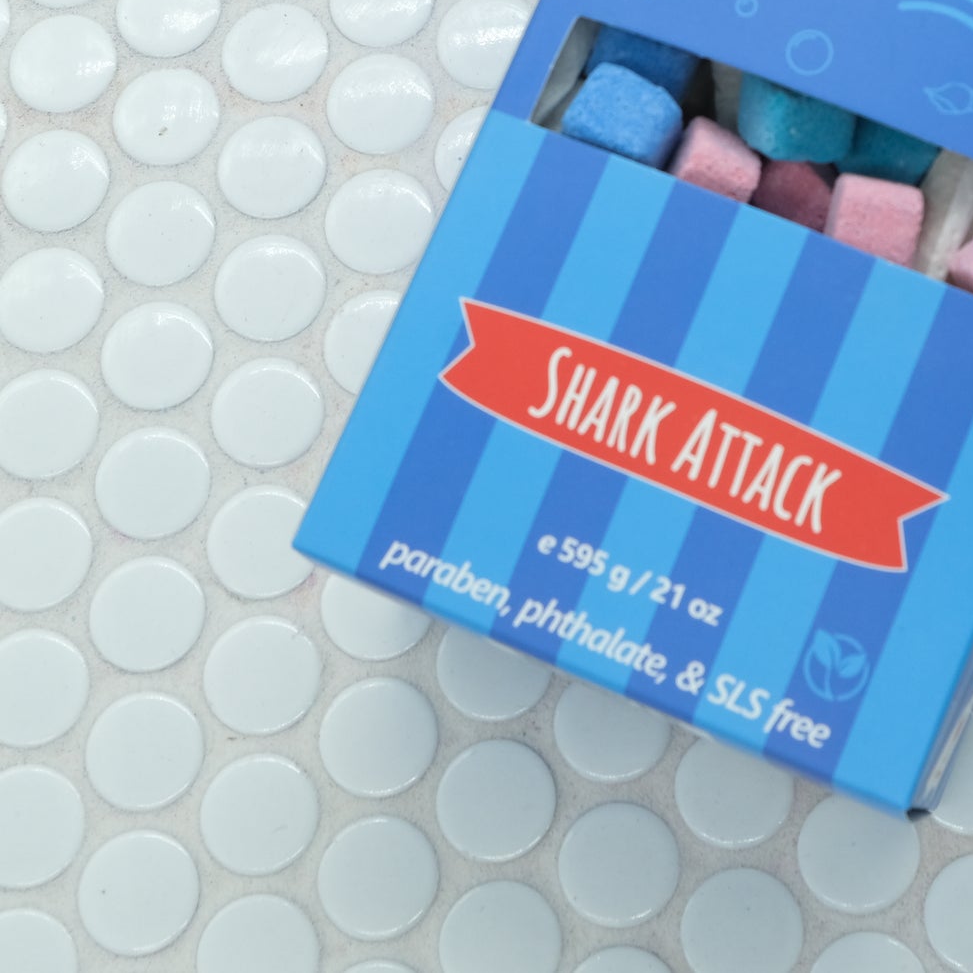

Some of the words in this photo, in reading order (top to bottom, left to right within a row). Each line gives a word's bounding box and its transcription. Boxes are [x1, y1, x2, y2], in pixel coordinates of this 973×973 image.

[527, 346, 677, 465] SHARK
[670, 407, 842, 534] ATTACK
[378, 540, 512, 618] paraben,
[511, 597, 669, 686] phthalate,
[674, 659, 706, 696] &
[706, 672, 771, 721] SLS
[762, 697, 832, 749] free
[557, 535, 610, 577] 595
[606, 563, 632, 593] g
[627, 569, 654, 596] /
[648, 575, 686, 610] 21
[687, 597, 724, 627] oz
